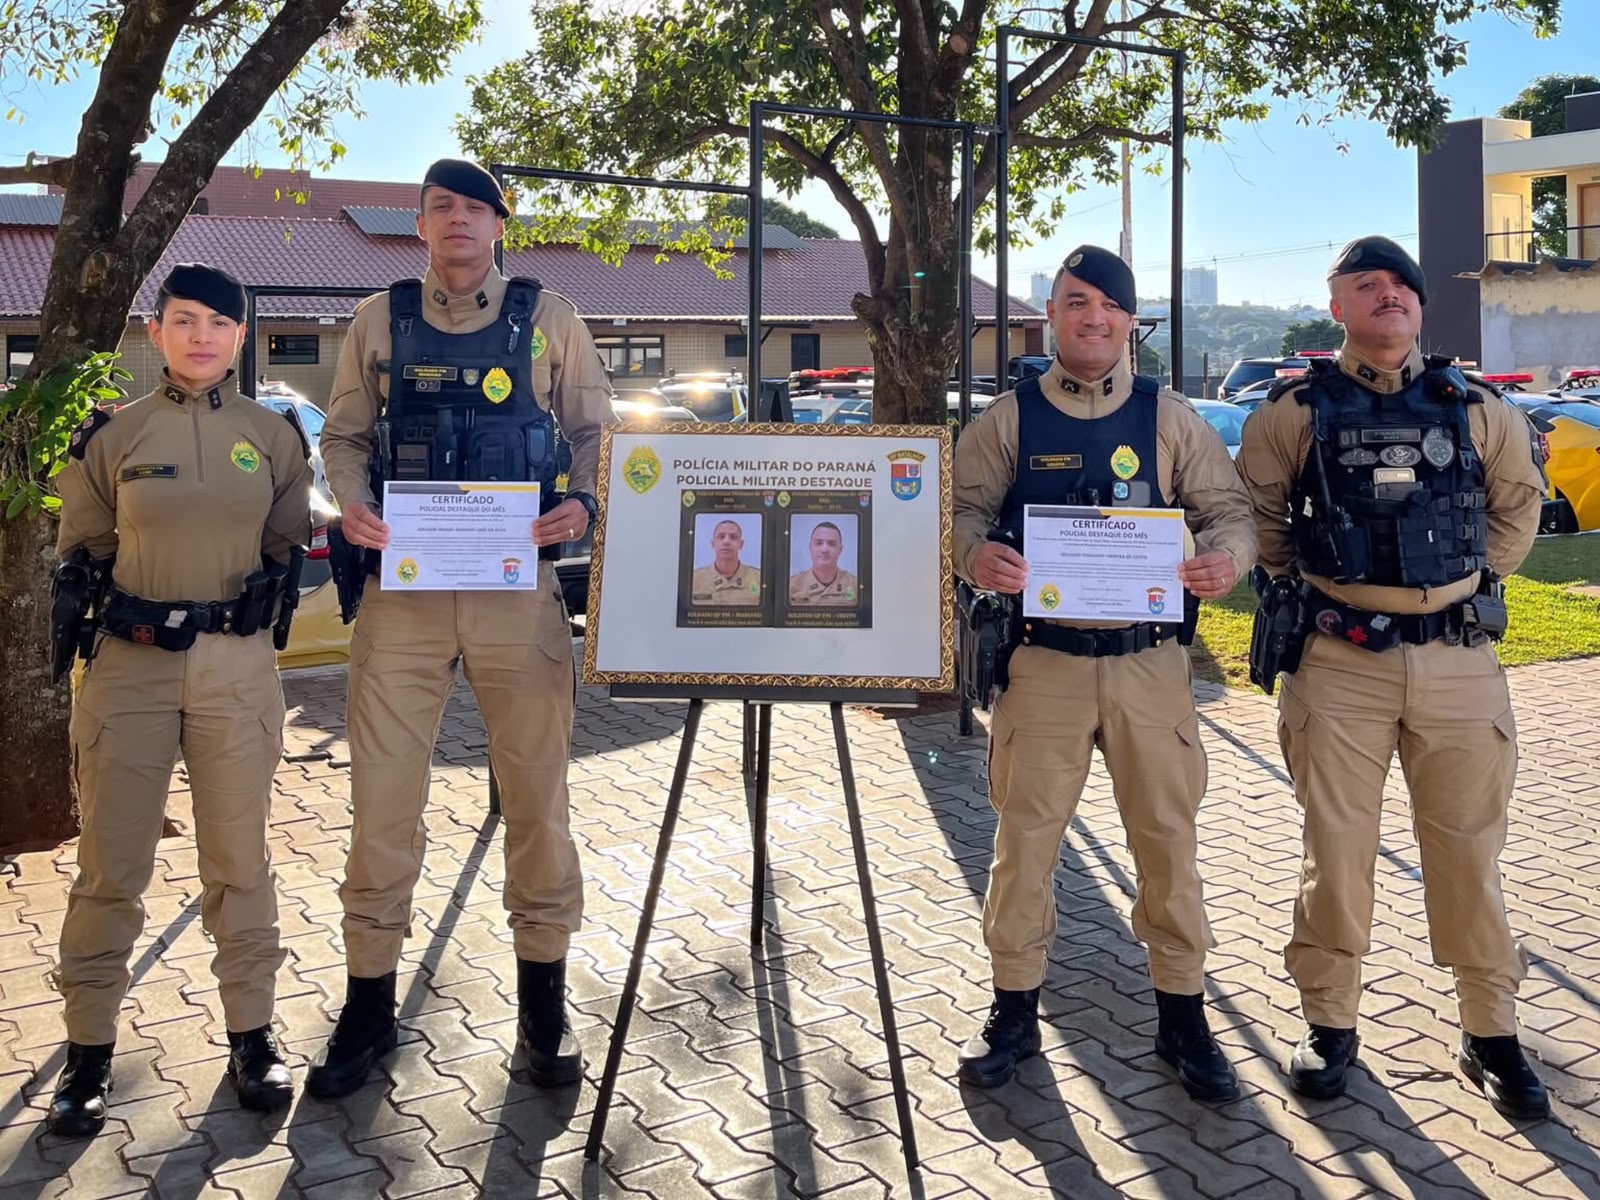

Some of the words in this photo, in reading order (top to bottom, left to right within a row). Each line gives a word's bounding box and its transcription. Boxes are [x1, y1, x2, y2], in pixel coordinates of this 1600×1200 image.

[1340, 431, 1358, 445] 01
[673, 457, 729, 470] POLÍCIA
[734, 460, 789, 471] MILITAR
[792, 461, 814, 472] DO
[817, 460, 876, 473] PARANÁ
[676, 475, 738, 486] POLICIAL
[742, 476, 796, 487] MILITAR
[800, 476, 872, 488] DESTAQUE
[432, 495, 494, 504] CERTIFICADO
[492, 505, 506, 513] MÊS
[1072, 520, 1136, 530] CERTIFICADO
[1134, 532, 1148, 540] MÊS
